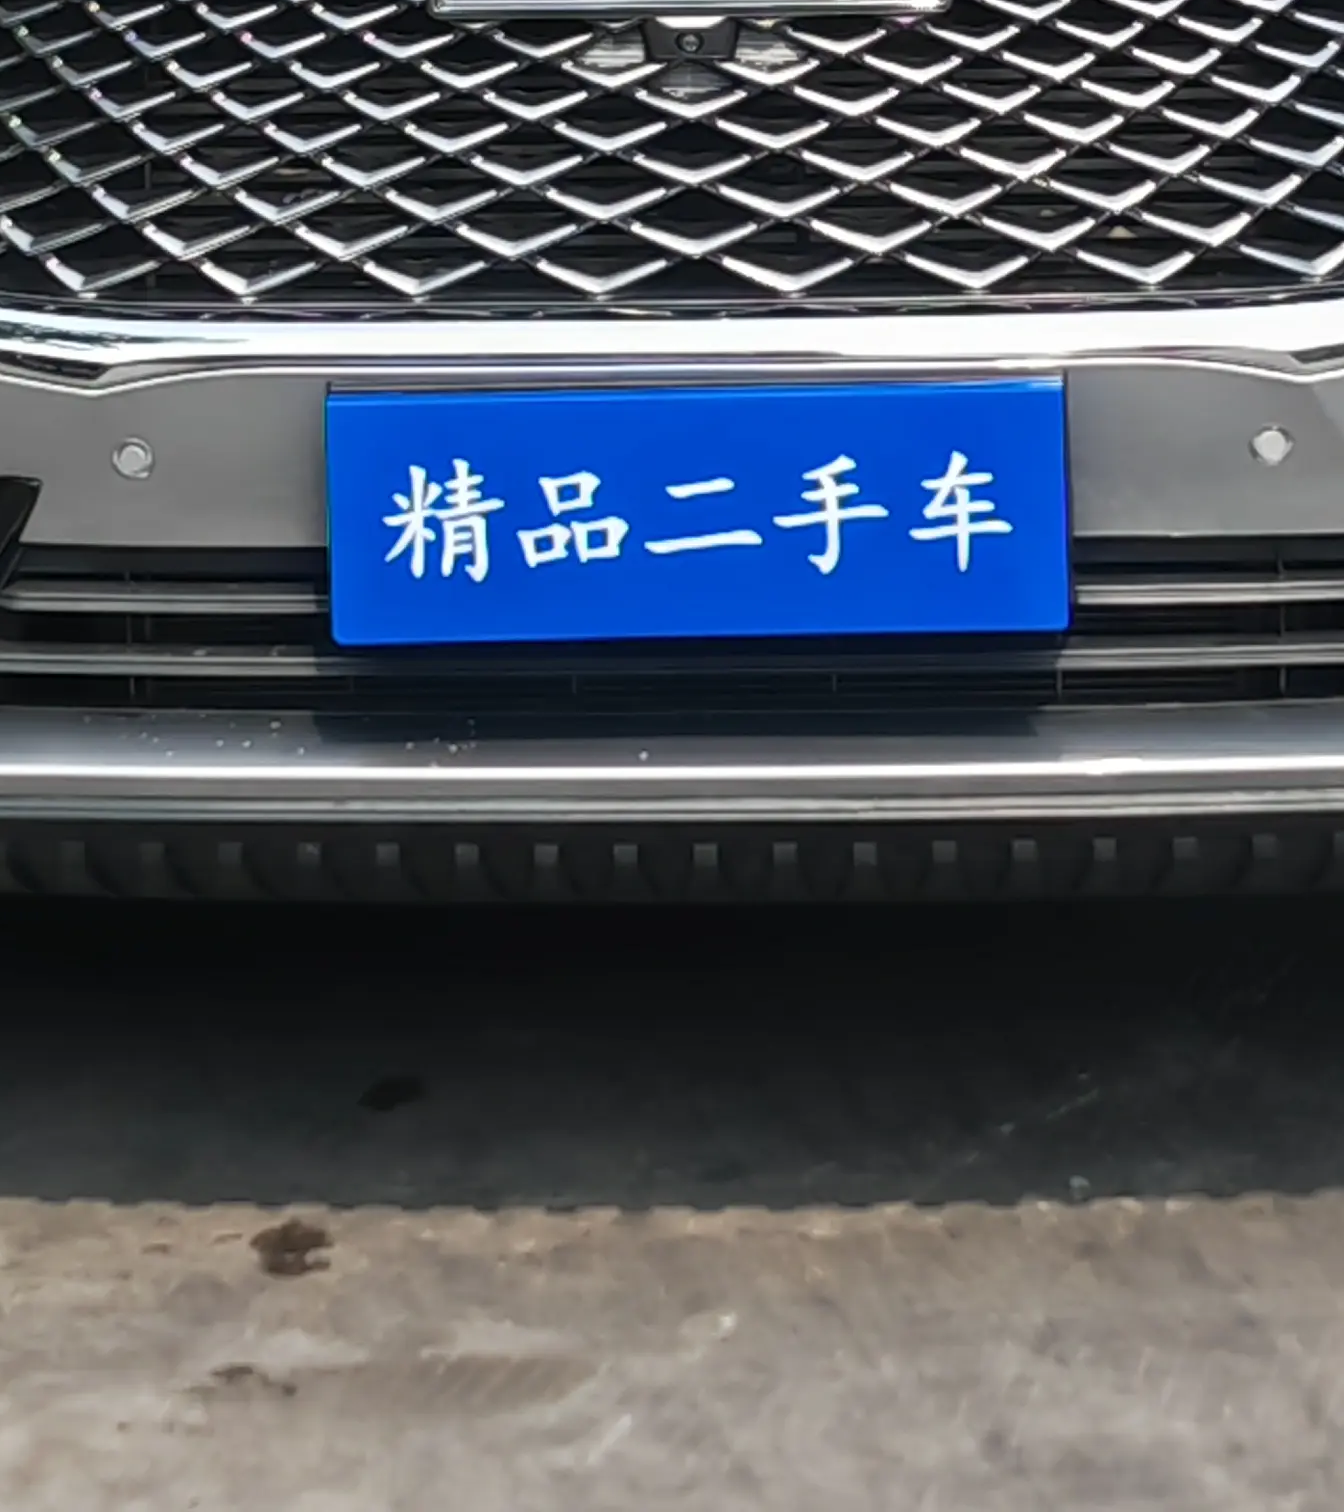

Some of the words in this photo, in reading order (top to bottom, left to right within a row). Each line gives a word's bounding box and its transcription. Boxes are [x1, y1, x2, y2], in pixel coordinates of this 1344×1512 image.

[382, 451, 1013, 582] 精品二手车
